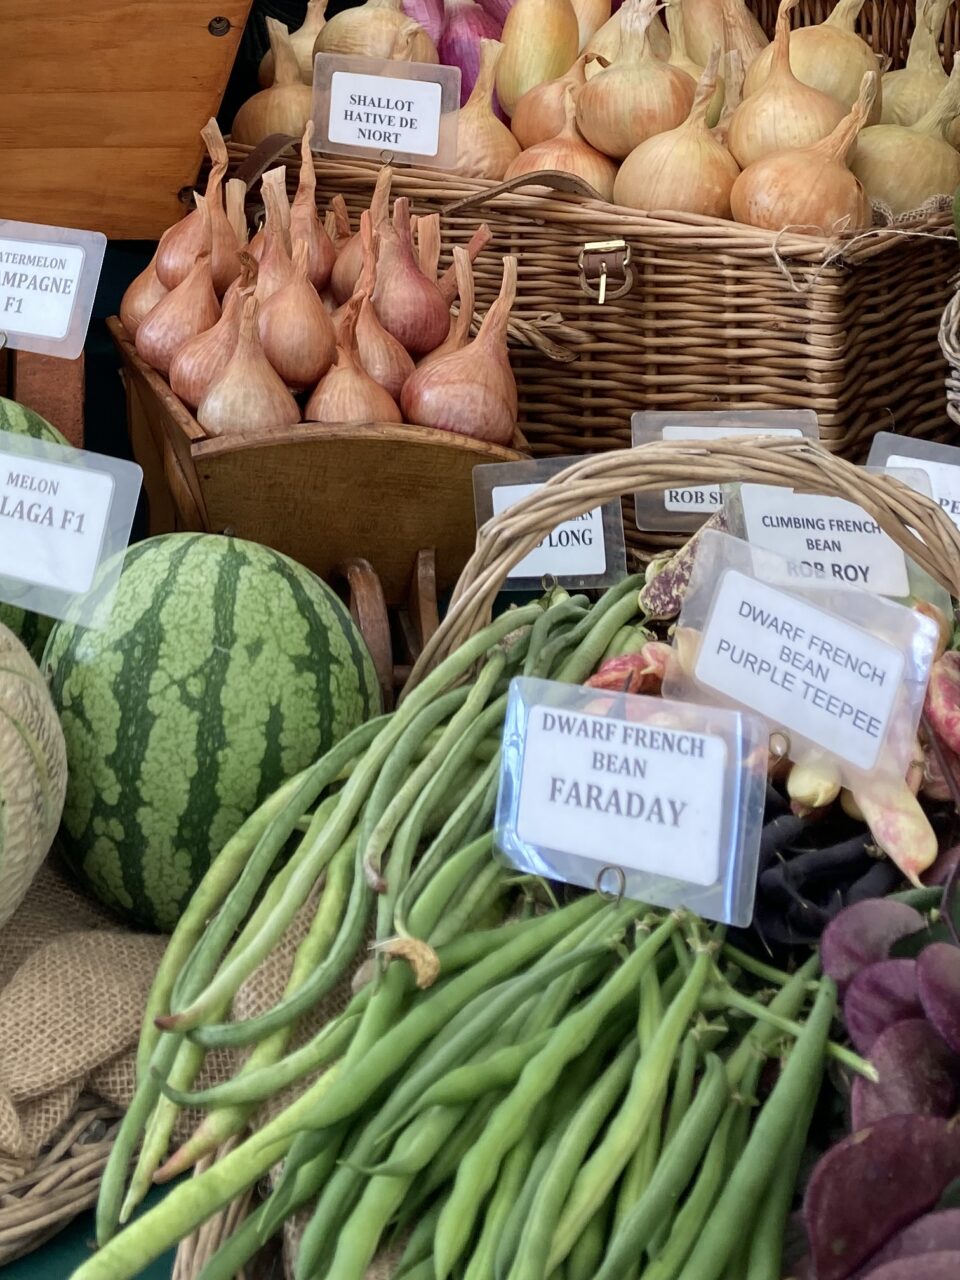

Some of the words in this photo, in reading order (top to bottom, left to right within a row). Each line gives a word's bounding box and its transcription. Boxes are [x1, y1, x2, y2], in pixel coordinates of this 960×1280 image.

[349, 94, 415, 112] SHALLOT
[344, 110, 396, 127] HATIVE
[399, 117, 418, 130] DE
[357, 128, 402, 144] NIORT
[3, 296, 24, 314] F1
[6, 472, 60, 496] MELON
[669, 490, 705, 504] ROB
[60, 509, 86, 534] F1
[762, 515, 825, 531] CLIMBING
[829, 519, 881, 534] FRENCH
[549, 529, 593, 547] LONG
[806, 538, 842, 553] BEAN
[787, 560, 826, 580] ROB
[832, 563, 869, 583] ROY
[739, 600, 805, 642] DWARF
[808, 635, 886, 686] FRENCH
[779, 645, 830, 683] BEAN
[717, 639, 796, 692] PURPLE
[802, 681, 882, 738] TEEPEE
[542, 712, 617, 740] DWARF
[622, 725, 705, 758] FRENCH
[592, 750, 647, 779] BEAN
[548, 776, 688, 828] FARADAY
